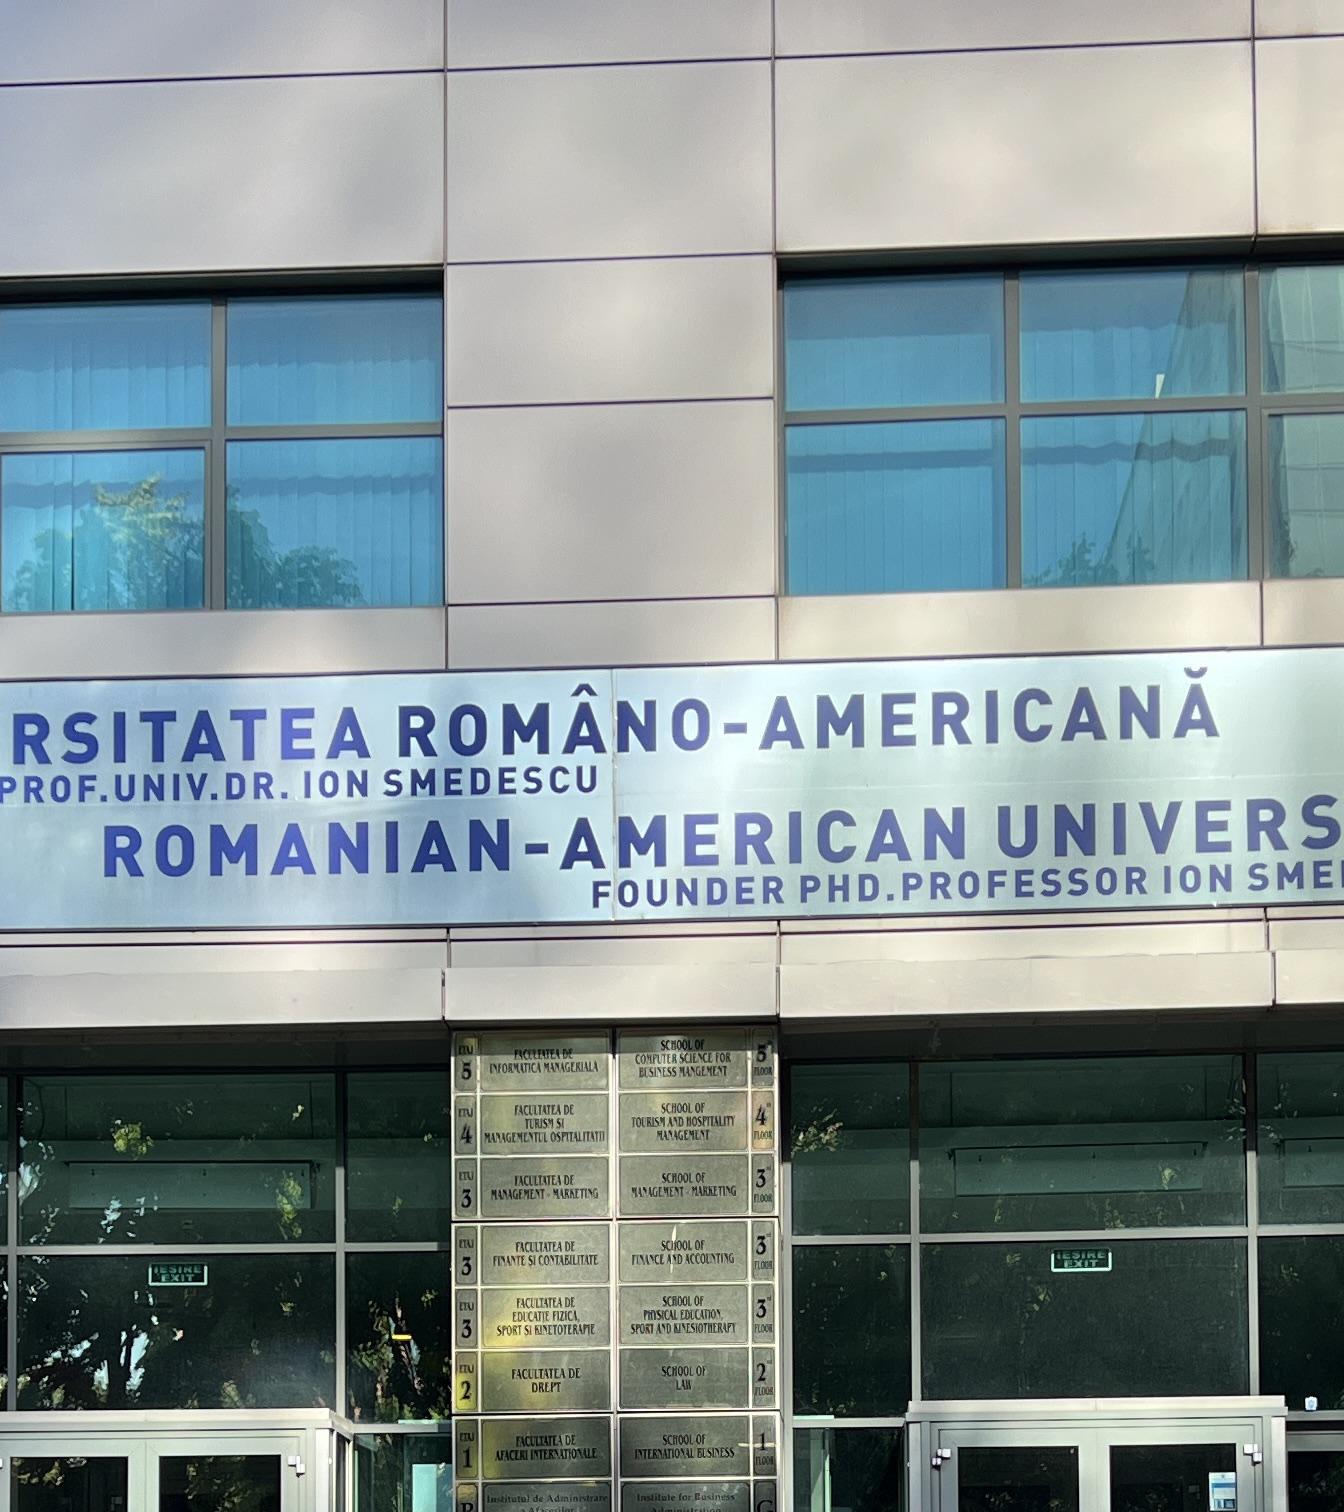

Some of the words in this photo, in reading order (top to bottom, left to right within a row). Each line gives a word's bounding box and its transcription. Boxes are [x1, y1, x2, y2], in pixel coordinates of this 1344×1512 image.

[399, 667, 1220, 757] ROMÂNO-AMERICANĂ
[303, 769, 369, 798] ION
[382, 765, 599, 797] SMEDESCU
[104, 806, 968, 878] ROMANIAN-AMERICAN
[592, 876, 784, 909] FOUNDER
[1164, 864, 1232, 893] ION
[661, 1039, 692, 1050] SCHOOL
[695, 1039, 705, 1049] OF
[514, 1049, 560, 1060] FACULTATEA
[563, 1048, 573, 1059] DE
[635, 1053, 677, 1064] COMPUTER
[680, 1052, 712, 1063] SCIENCE
[716, 1052, 731, 1062] FOR
[461, 1063, 472, 1079] 5
[490, 1062, 541, 1073] INFORMATICA
[544, 1061, 598, 1072] MANAGERIALA
[639, 1066, 676, 1077] BUSINESS
[754, 1067, 772, 1075] FLOOR
[514, 1105, 561, 1115] FACULTATEA
[564, 1104, 574, 1115] DE
[661, 1103, 692, 1114] SCHOOL
[695, 1102, 705, 1113] OF
[525, 1119, 553, 1129] TURISM
[632, 1117, 665, 1128] TOURISM
[668, 1117, 684, 1127] AND
[686, 1116, 735, 1127] HOSPITALITY
[461, 1123, 472, 1144] 4
[484, 1132, 547, 1143] MANAGEMENTUL
[657, 1130, 709, 1141] MANAGEMENT
[754, 1131, 772, 1139] FLOOR
[515, 1175, 561, 1186] FACULTATEA
[564, 1175, 574, 1185] DE
[662, 1173, 692, 1183] SCHOOL
[696, 1172, 705, 1183] OF
[491, 1189, 545, 1200] MANAGEMENT
[553, 1188, 598, 1199] MARKETING
[632, 1187, 683, 1197] MANAGEMENT
[692, 1186, 736, 1196] MARKETING
[461, 1189, 471, 1208] 3
[754, 1194, 772, 1203] FLOOR
[516, 1242, 562, 1252] FACULTATEA
[565, 1241, 575, 1252] DE
[661, 1240, 692, 1251] SCHOOL
[695, 1240, 705, 1250] OF
[539, 1254, 598, 1265] CONTABILITATE
[632, 1254, 664, 1265] FINANCE
[667, 1254, 683, 1265] AND
[686, 1253, 734, 1264] ACCOUNTING
[1064, 1260, 1099, 1268] EXIT
[461, 1257, 472, 1275] 3
[754, 1261, 772, 1269] FLOOR
[161, 1274, 195, 1282] EXIT
[516, 1298, 562, 1308] FACULTATEA
[565, 1297, 575, 1307] DE
[662, 1296, 692, 1306] SCHOOL
[694, 1296, 704, 1306] OF
[644, 1310, 677, 1320] PHYSICAL
[461, 1319, 472, 1338] 3
[497, 1325, 521, 1336] SPORT
[535, 1324, 595, 1335] KINETOTERAPIE
[631, 1324, 653, 1334] SPORT
[657, 1323, 671, 1334] AND
[674, 1323, 736, 1333] KINESIOTHERAPY
[755, 1324, 772, 1333] FLOOR
[512, 1369, 565, 1379] FACULTATEA
[569, 1368, 580, 1379] DE
[662, 1366, 693, 1376] SCHOOL
[696, 1366, 706, 1376] OF
[461, 1380, 471, 1400] 2
[532, 1382, 561, 1392] DREPT
[676, 1380, 691, 1390] LAW
[755, 1387, 773, 1396] FLOOR
[516, 1435, 562, 1447] FACULTATEA
[565, 1435, 576, 1445] DE
[663, 1434, 693, 1445] SCHOOL
[696, 1434, 705, 1444] OF
[463, 1447, 472, 1468] 1
[495, 1450, 528, 1461] AFACERI
[635, 1448, 694, 1459] INTERNATIONAL
[697, 1447, 734, 1458] BUSINESS
[756, 1456, 774, 1465] FLOOR
[487, 1495, 529, 1503] Institutul
[547, 1494, 607, 1503] Administrare
[637, 1493, 675, 1501] Institute
[694, 1492, 735, 1500] Business
